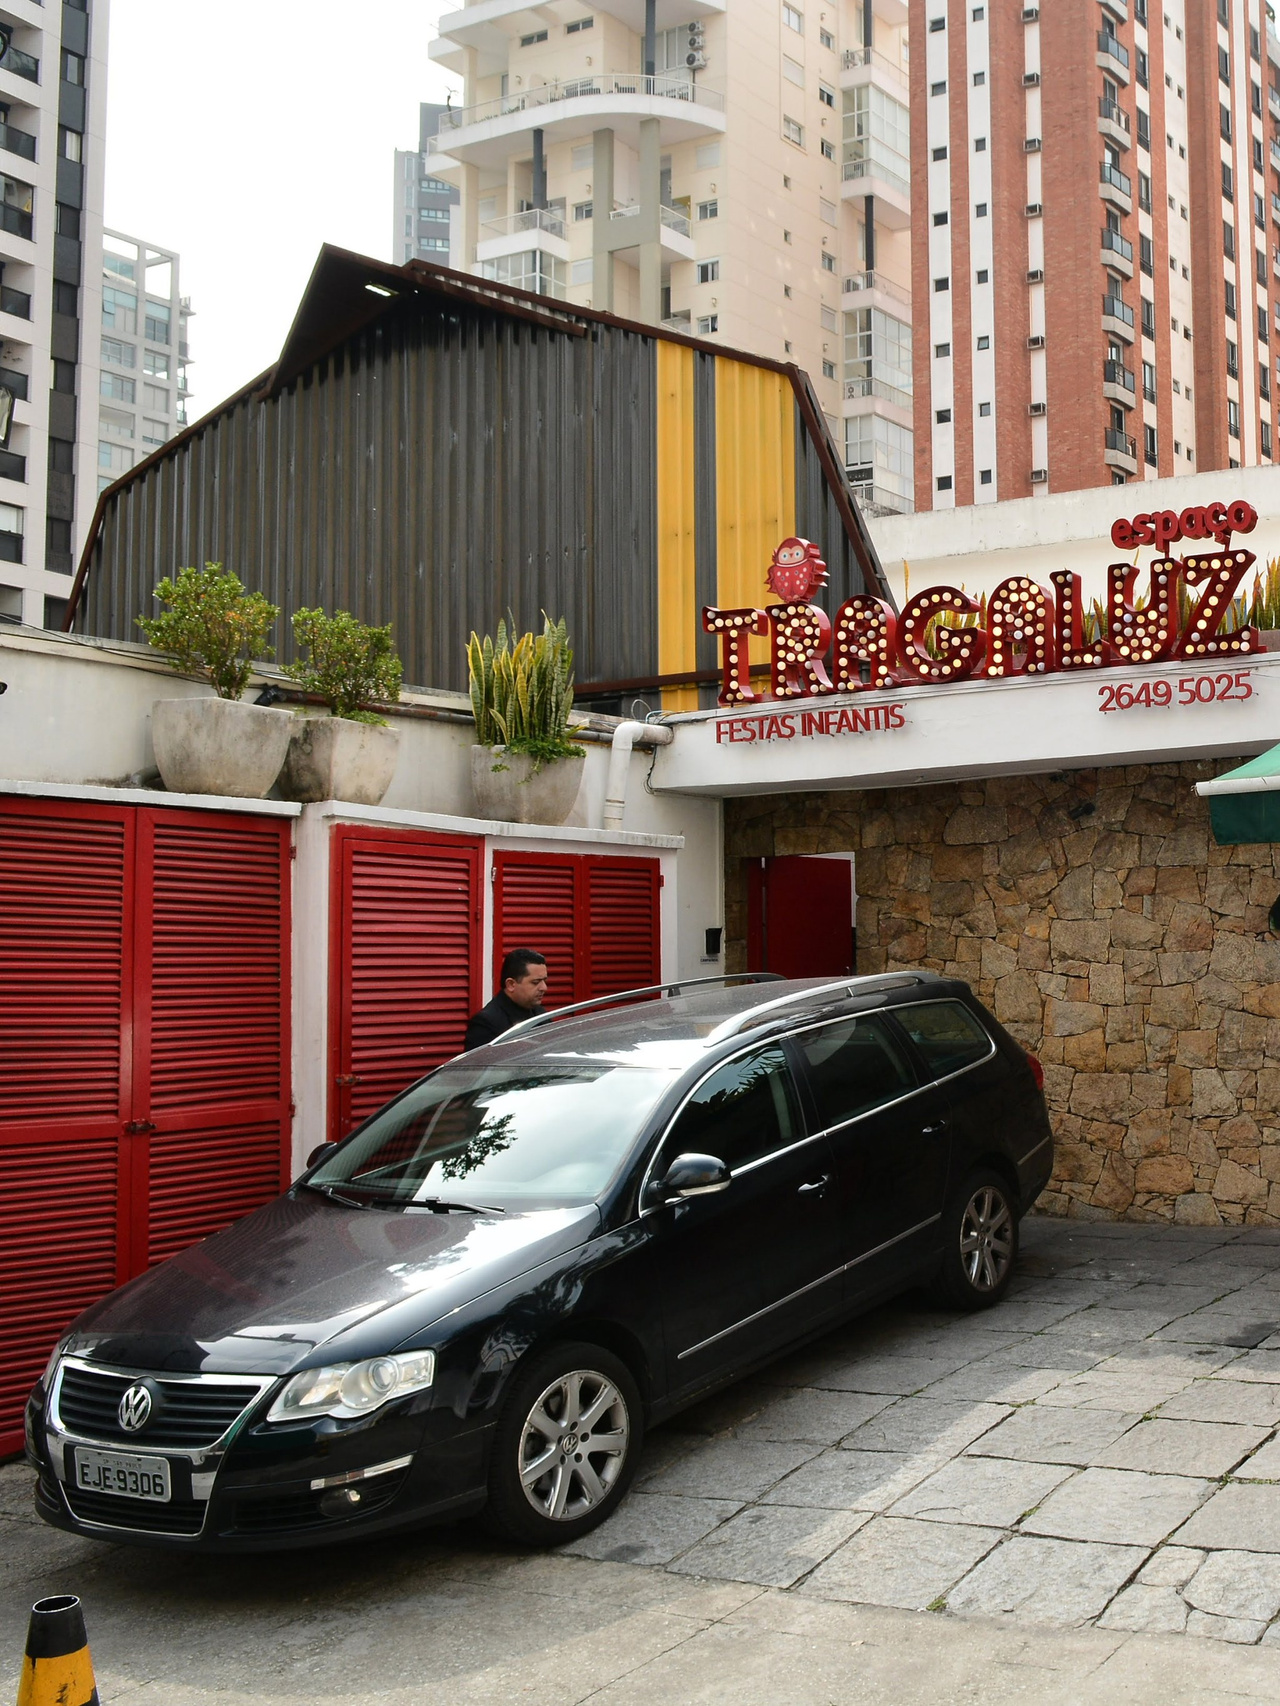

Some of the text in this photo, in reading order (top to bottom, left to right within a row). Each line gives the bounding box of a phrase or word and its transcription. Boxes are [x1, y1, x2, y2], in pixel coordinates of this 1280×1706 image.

[1111, 500, 1258, 552] espaço
[702, 549, 1259, 707] TRAGALUZ
[1099, 673, 1253, 711] 2649 5025
[716, 704, 906, 743] FESTAS INFANTIS
